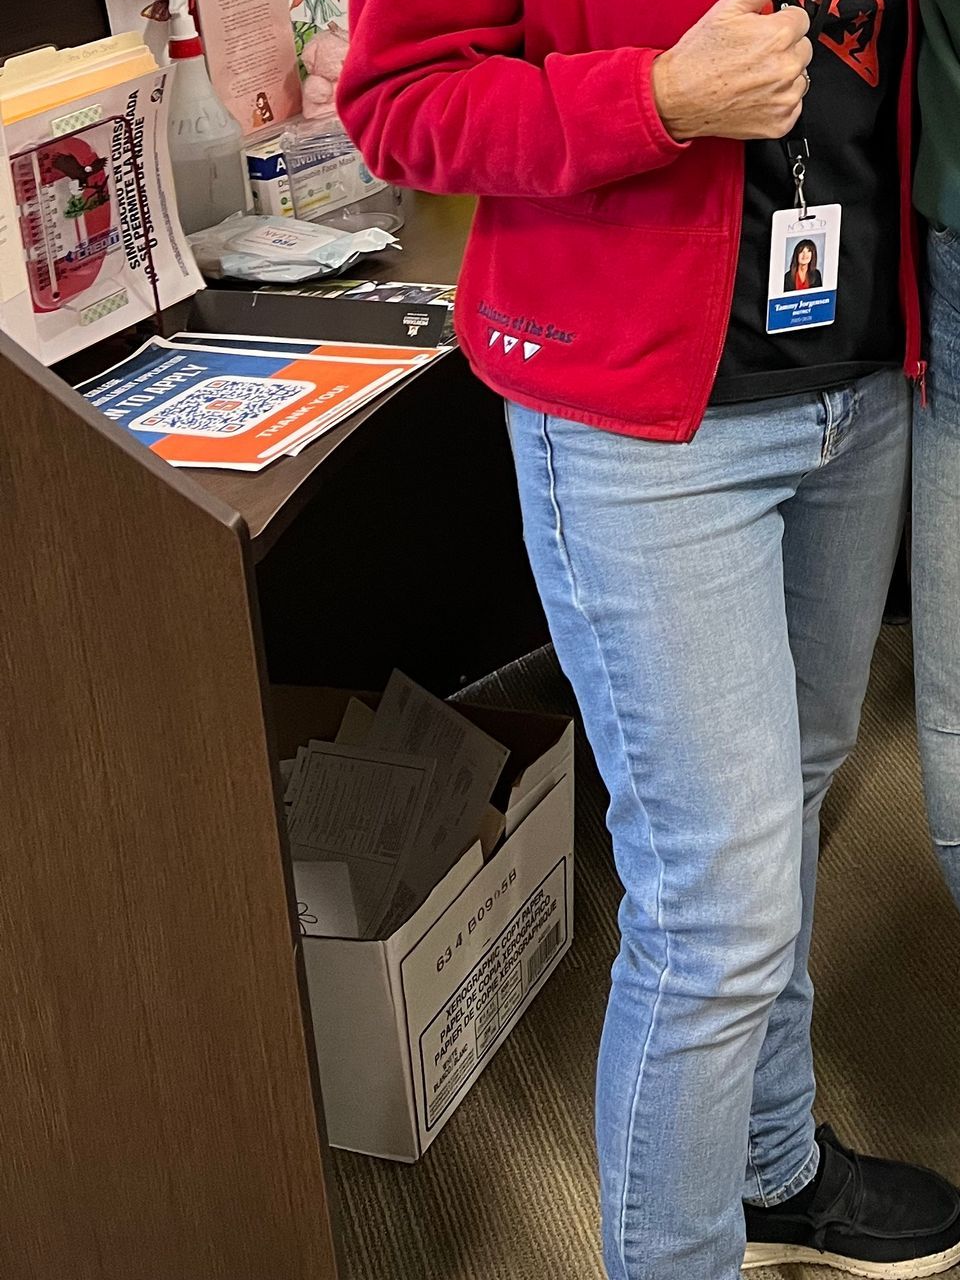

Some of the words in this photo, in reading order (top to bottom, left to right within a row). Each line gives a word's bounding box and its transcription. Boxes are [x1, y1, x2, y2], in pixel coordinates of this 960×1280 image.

[123, 157, 134, 176] LA
[133, 116, 145, 160] NADIE
[124, 178, 145, 241] PERMITE
[115, 395, 156, 407] TO
[143, 363, 209, 395] APPLY
[255, 406, 316, 439] THANK
[308, 384, 350, 407] YOU!
[445, 945, 501, 1021] XEROGRAPHIC
[501, 918, 521, 949] COPY
[522, 888, 544, 923] PAPER
[434, 1023, 463, 1067] PAPIER
[463, 1007, 476, 1028] DE
[475, 976, 499, 1012] COPIE
[440, 1007, 465, 1044] PAPEL
[466, 988, 478, 1010] DE
[478, 960, 502, 993] COPIA
